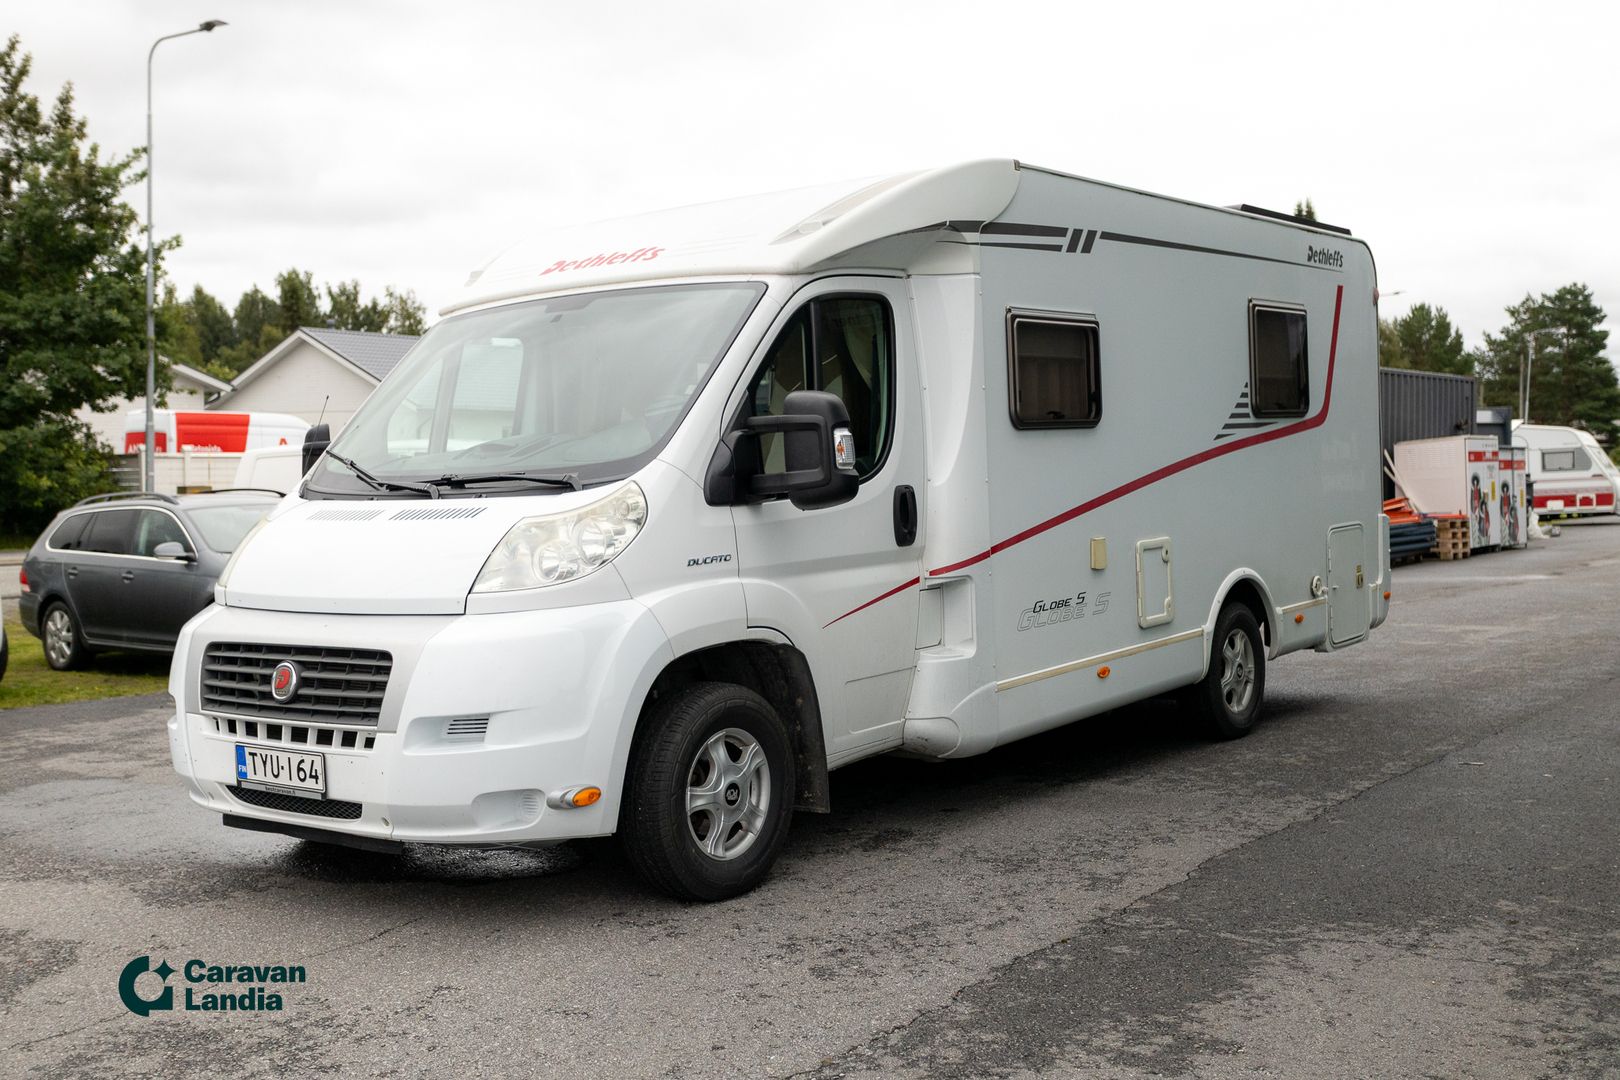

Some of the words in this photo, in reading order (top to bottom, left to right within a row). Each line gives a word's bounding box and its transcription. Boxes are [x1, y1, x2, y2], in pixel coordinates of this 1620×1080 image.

[538, 246, 665, 276] Dethleffs
[1307, 245, 1344, 268] Dethleffs
[687, 554, 732, 567] DUCATO
[1076, 591, 1087, 605] S
[1092, 592, 1111, 616] S
[248, 751, 320, 785] TYU-164
